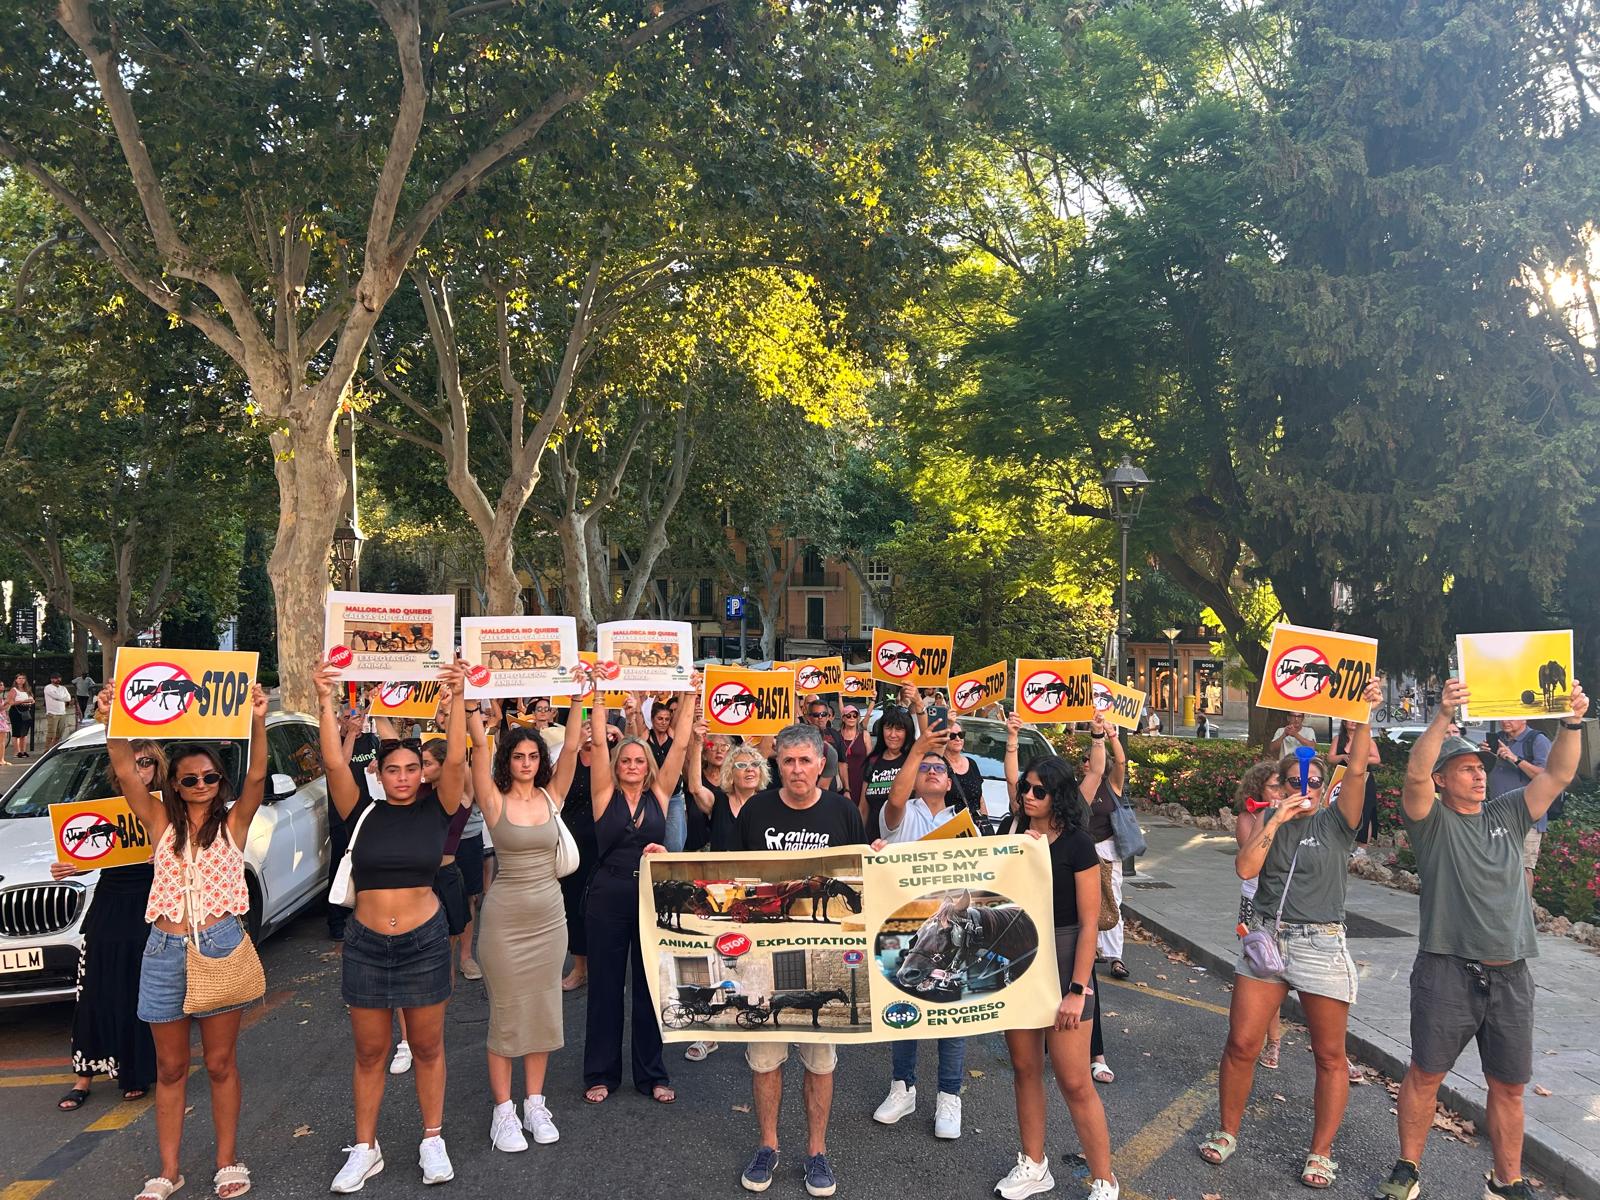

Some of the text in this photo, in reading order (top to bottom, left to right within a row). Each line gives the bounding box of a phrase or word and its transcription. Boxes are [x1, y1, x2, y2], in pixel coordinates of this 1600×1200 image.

[731, 598, 740, 615] P
[332, 650, 350, 664] STOP
[918, 648, 948, 676] STOP
[824, 665, 842, 685] STOP
[1329, 658, 1371, 702] STOP
[200, 670, 249, 717] STOP
[984, 672, 1005, 698] STOP
[757, 687, 790, 720] BASTA
[1113, 694, 1141, 720] PROU
[785, 829, 829, 844] anima
[864, 845, 1024, 865] TOURIST SAVE ME,
[912, 860, 979, 875] END MY
[899, 871, 996, 888] SUFFERING
[658, 937, 867, 949] ANIMAL EXPLOITATION
[720, 937, 746, 953] STOP
[3, 951, 40, 969] LLM
[927, 1001, 1006, 1017] PROGRESO
[927, 1011, 1000, 1026] EN VERDE
